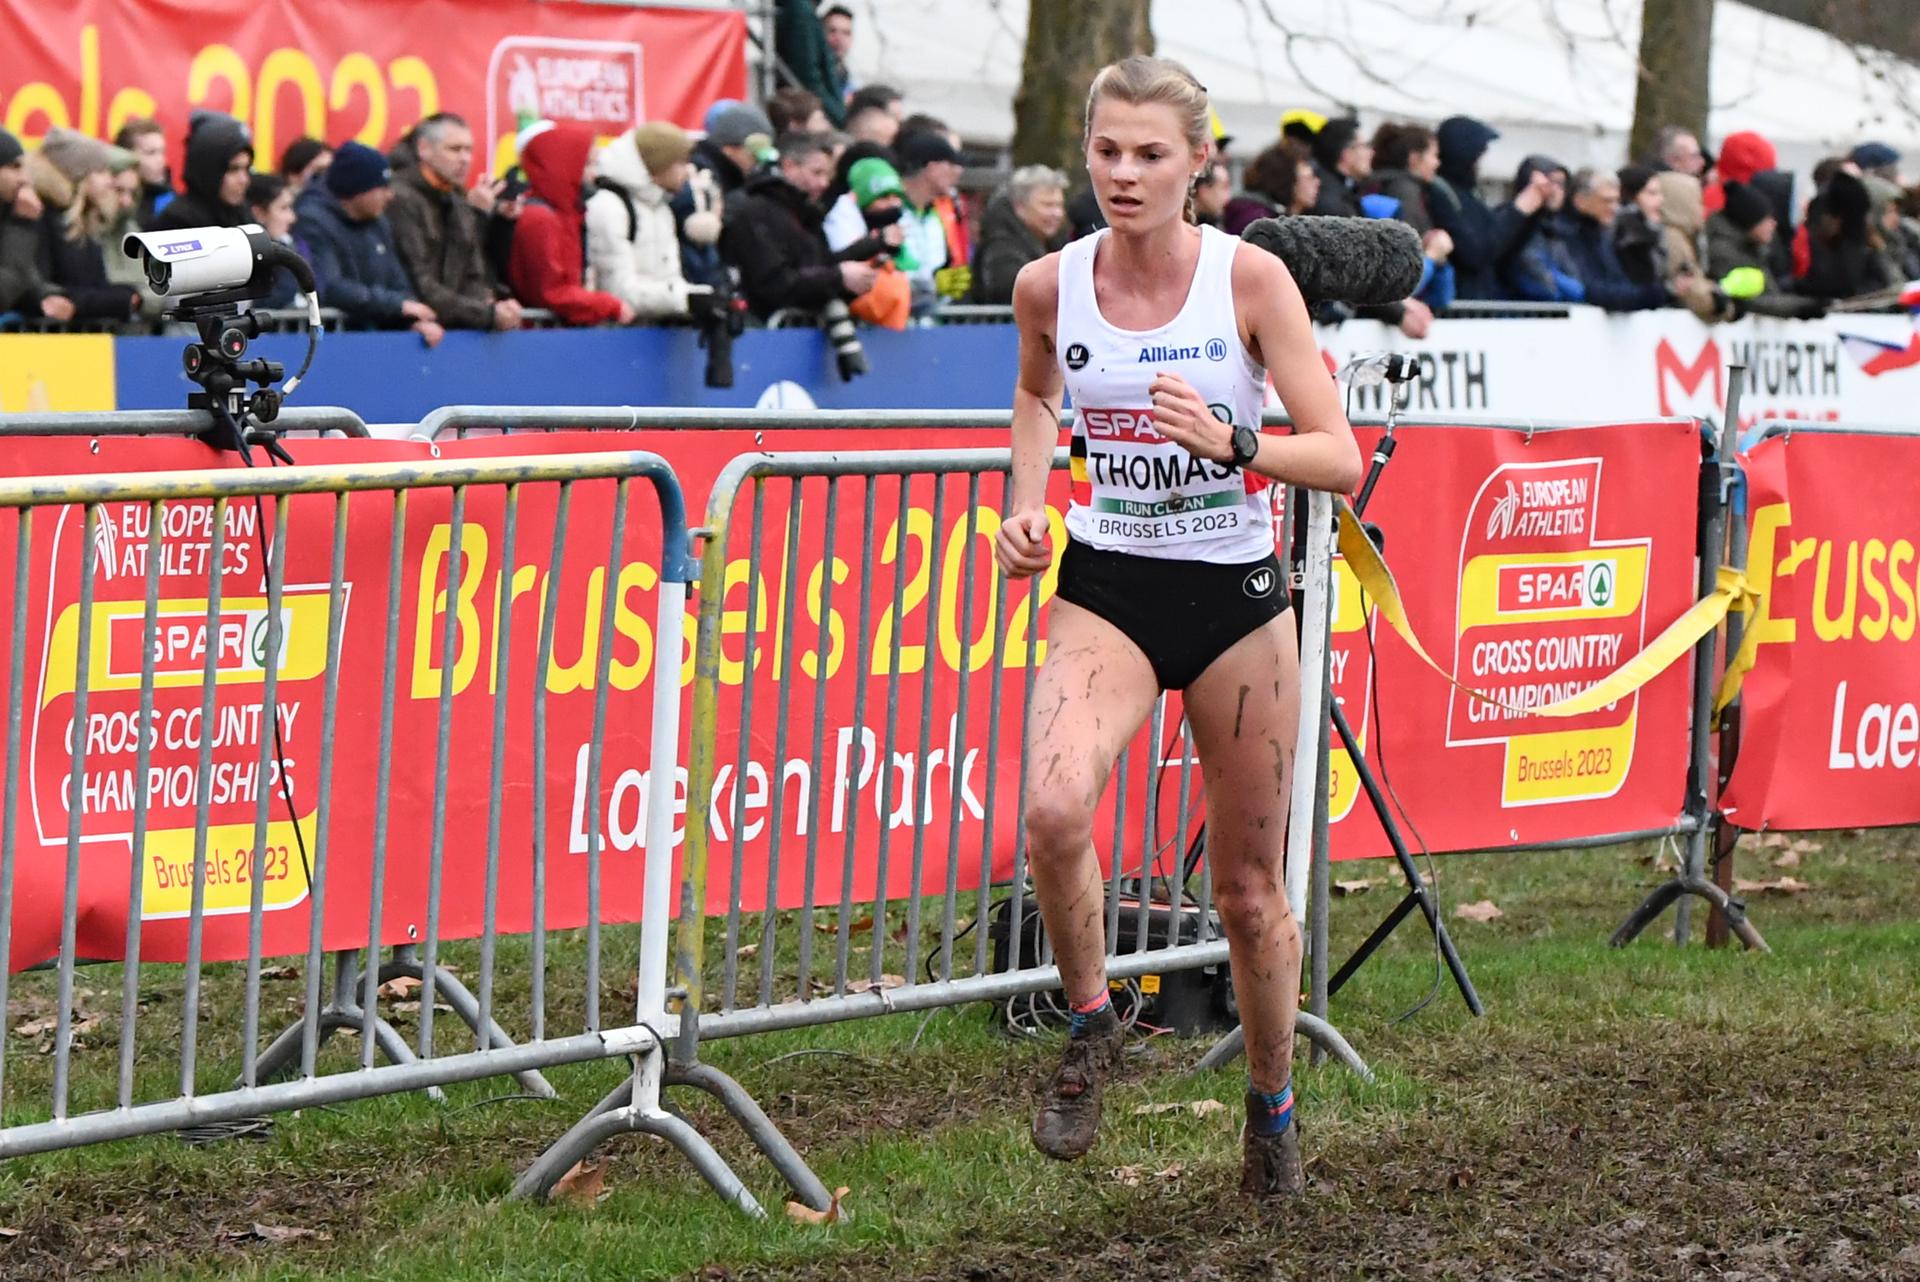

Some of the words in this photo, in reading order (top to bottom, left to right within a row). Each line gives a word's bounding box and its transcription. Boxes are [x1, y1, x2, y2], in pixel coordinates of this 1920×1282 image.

[1138, 345, 1201, 363] Allianz
[1087, 412, 1167, 440] SPA
[1120, 500, 1124, 513] I
[1126, 500, 1151, 516] RUN
[1521, 477, 1588, 508] EUROPEAN
[1099, 519, 1188, 539] BRUSSELS
[1192, 512, 1239, 533] 2023
[1513, 507, 1585, 537] ATHLETICS
[121, 542, 250, 578] ATHLETCS
[1518, 571, 1583, 603] SPAR
[146, 623, 243, 663] SPAR
[1472, 638, 1531, 677] CROSS
[1534, 632, 1623, 671] COUNTRY
[1468, 679, 1618, 722] CHAMPIONS
[65, 709, 161, 756] CROSS
[164, 701, 300, 752] COUNTY
[831, 711, 985, 833] Park
[1518, 749, 1573, 783] Brussels
[1576, 747, 1613, 776] 2023
[153, 848, 231, 889] Brusels
